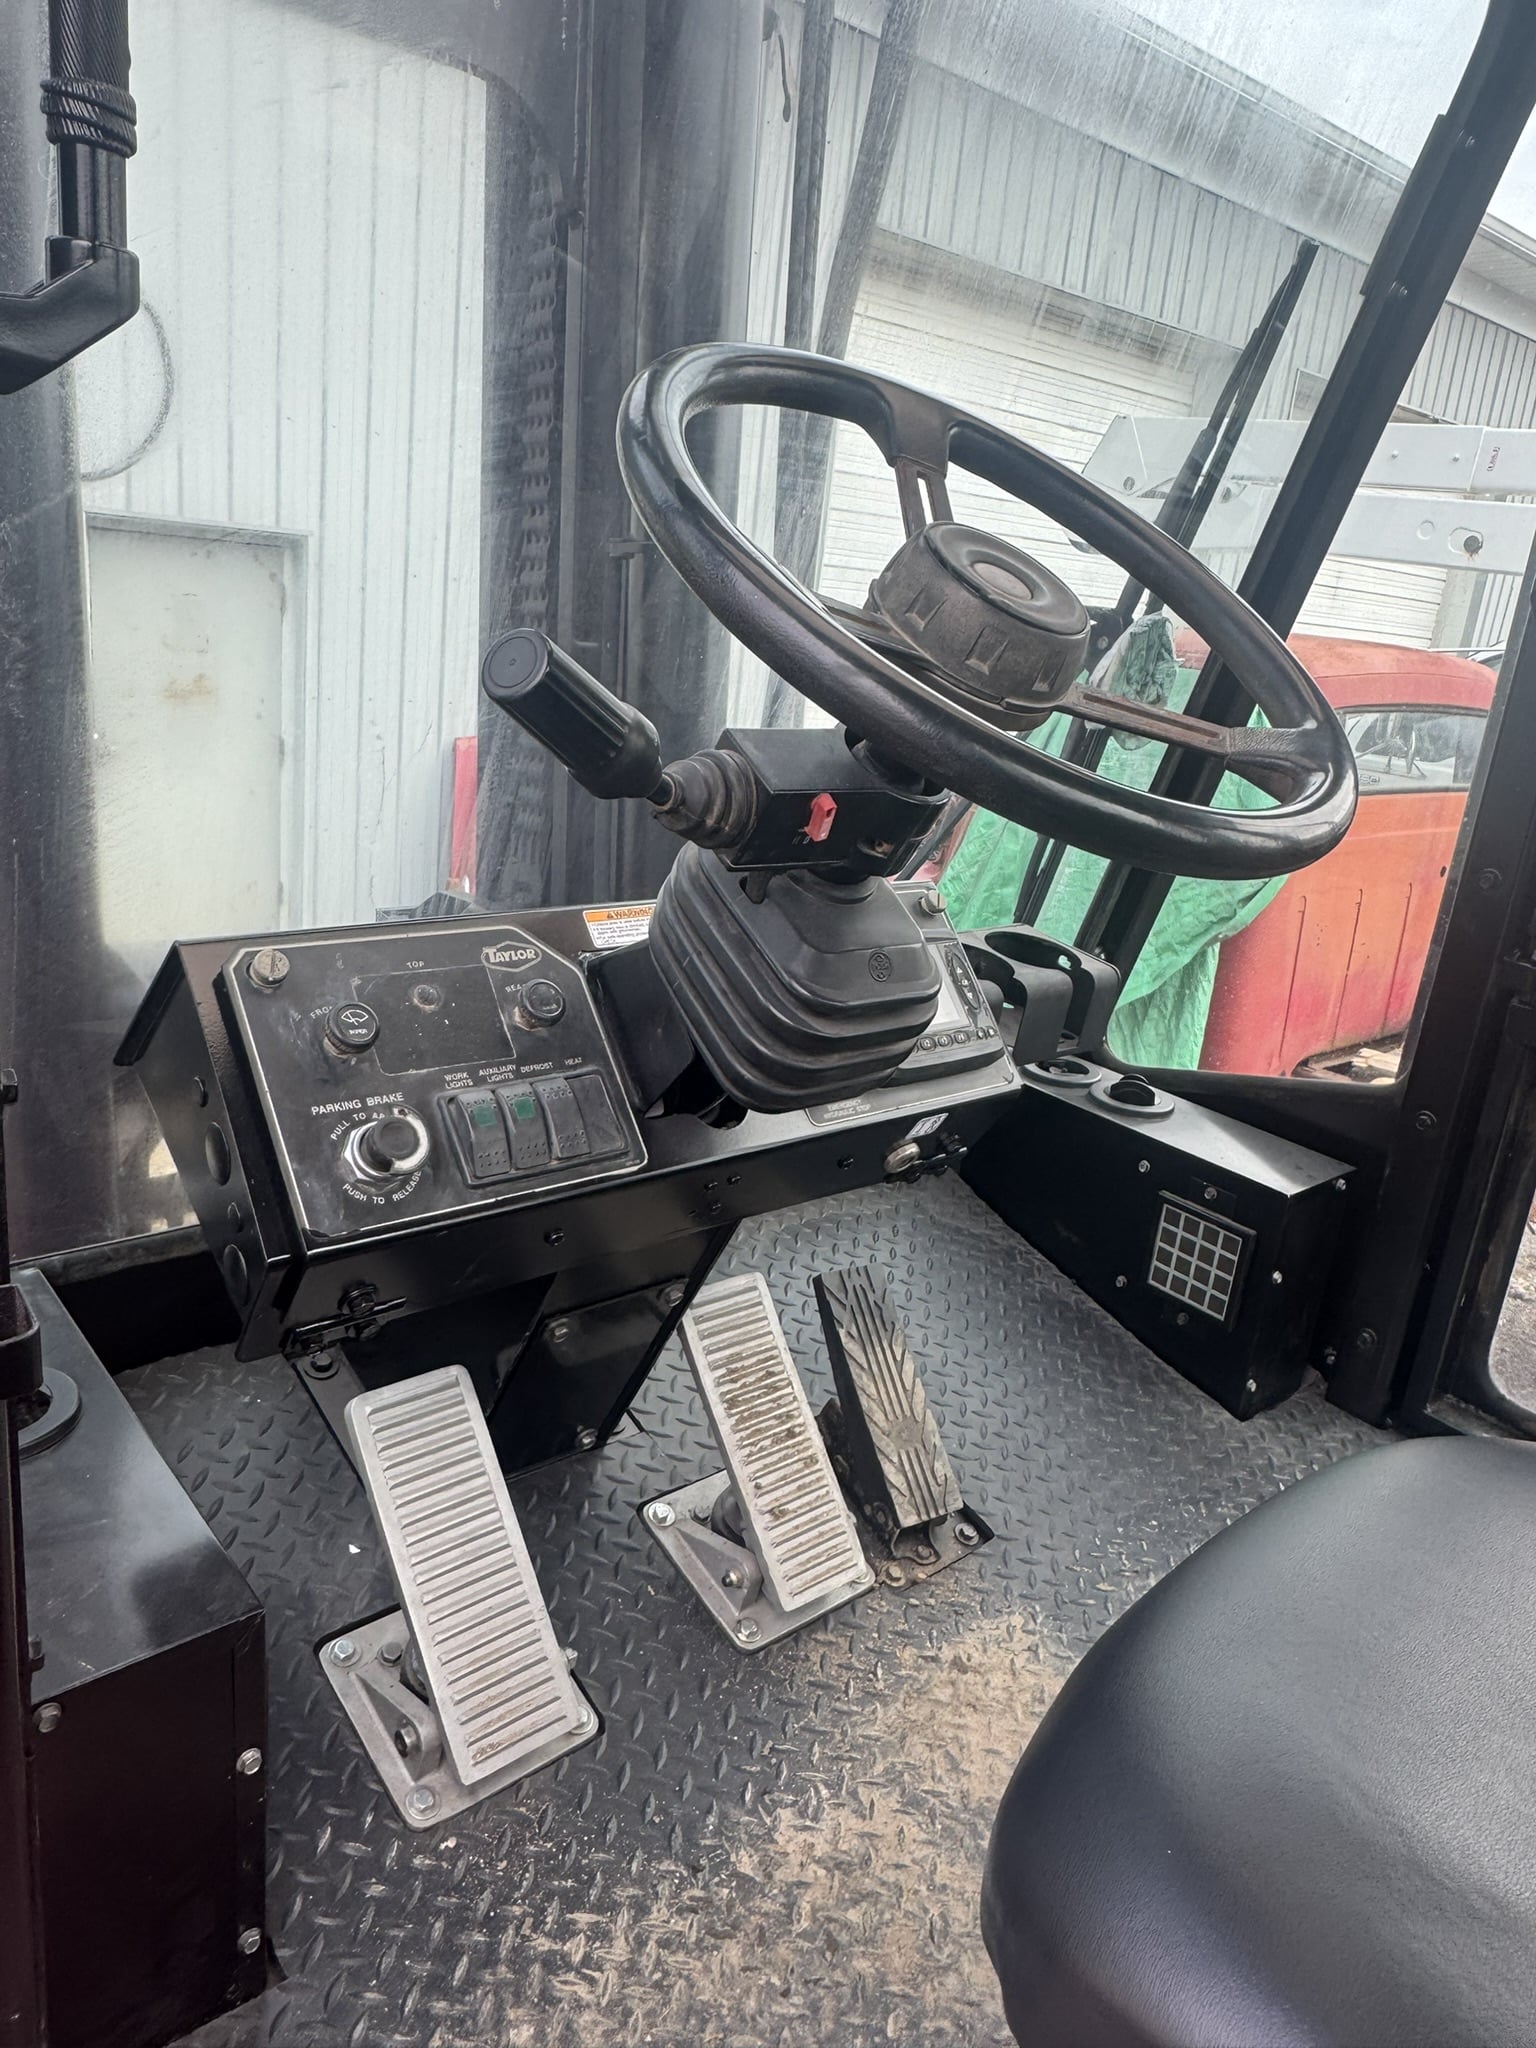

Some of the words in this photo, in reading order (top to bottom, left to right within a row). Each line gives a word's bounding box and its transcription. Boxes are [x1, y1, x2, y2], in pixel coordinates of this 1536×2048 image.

[486, 949, 537, 963] TAYLOR
[406, 960, 425, 969] TOP
[504, 983, 522, 993] REA
[309, 1005, 333, 1020] FRO
[478, 1063, 517, 1077] AUXILIARY
[520, 1061, 554, 1074] DEFROST
[443, 1071, 470, 1081] WORK
[486, 1072, 514, 1083] LIGHTS
[445, 1078, 474, 1090] LIGHTS
[311, 1099, 362, 1116] PARKING
[366, 1092, 405, 1106] BRAKE
[330, 1120, 351, 1141] PULL
[352, 1112, 367, 1121] TO
[342, 1183, 367, 1202] PUSH
[372, 1196, 385, 1205] TO
[392, 1171, 422, 1202] RELEASE
